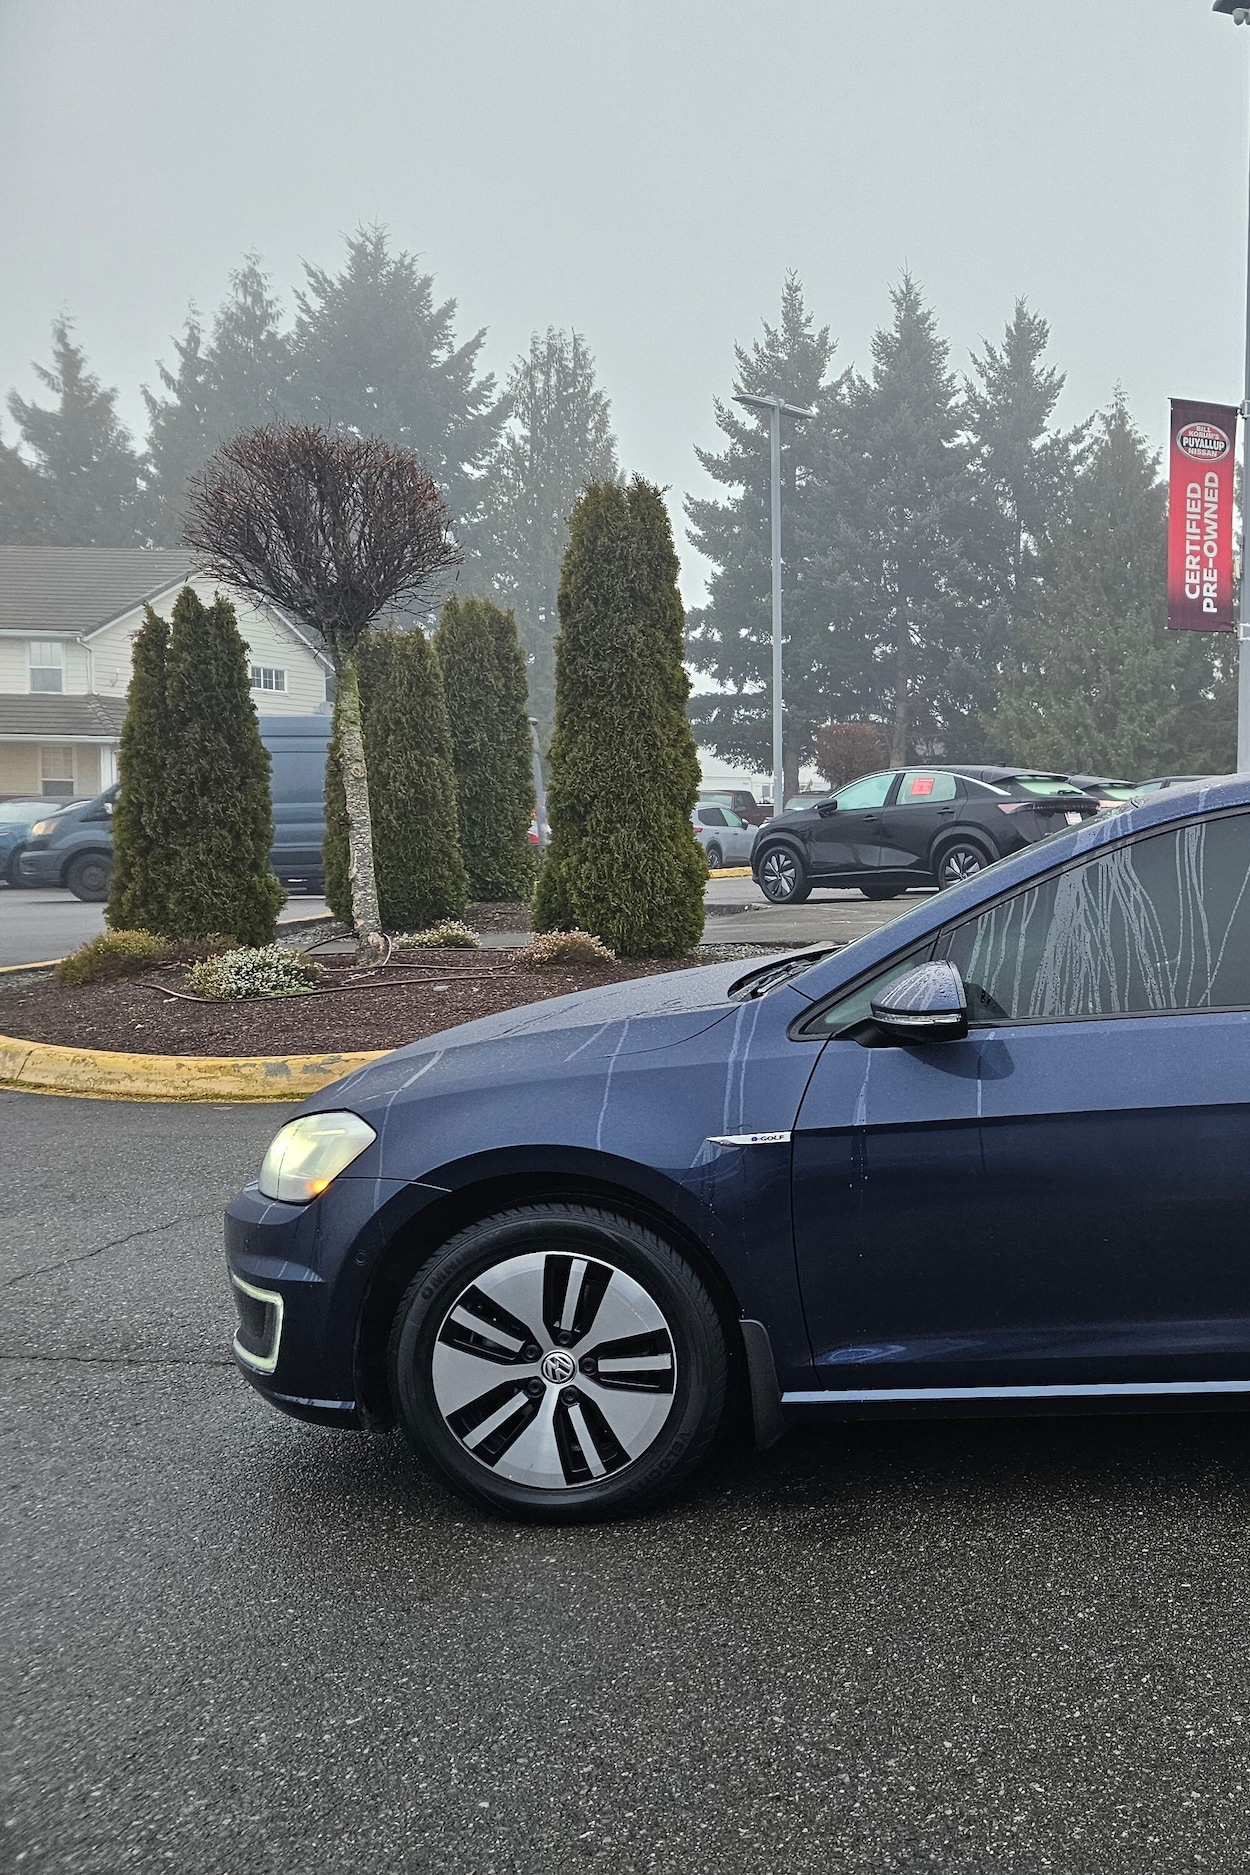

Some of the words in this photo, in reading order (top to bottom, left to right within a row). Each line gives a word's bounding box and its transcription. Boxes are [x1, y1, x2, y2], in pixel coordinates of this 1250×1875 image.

[1189, 431, 1219, 439] KORUM'S
[1182, 437, 1225, 451] PUYALLUP
[1188, 448, 1218, 457] NISSAN
[1185, 483, 1202, 599] CERTIFIED
[1202, 472, 1219, 613] PRE-OWNED
